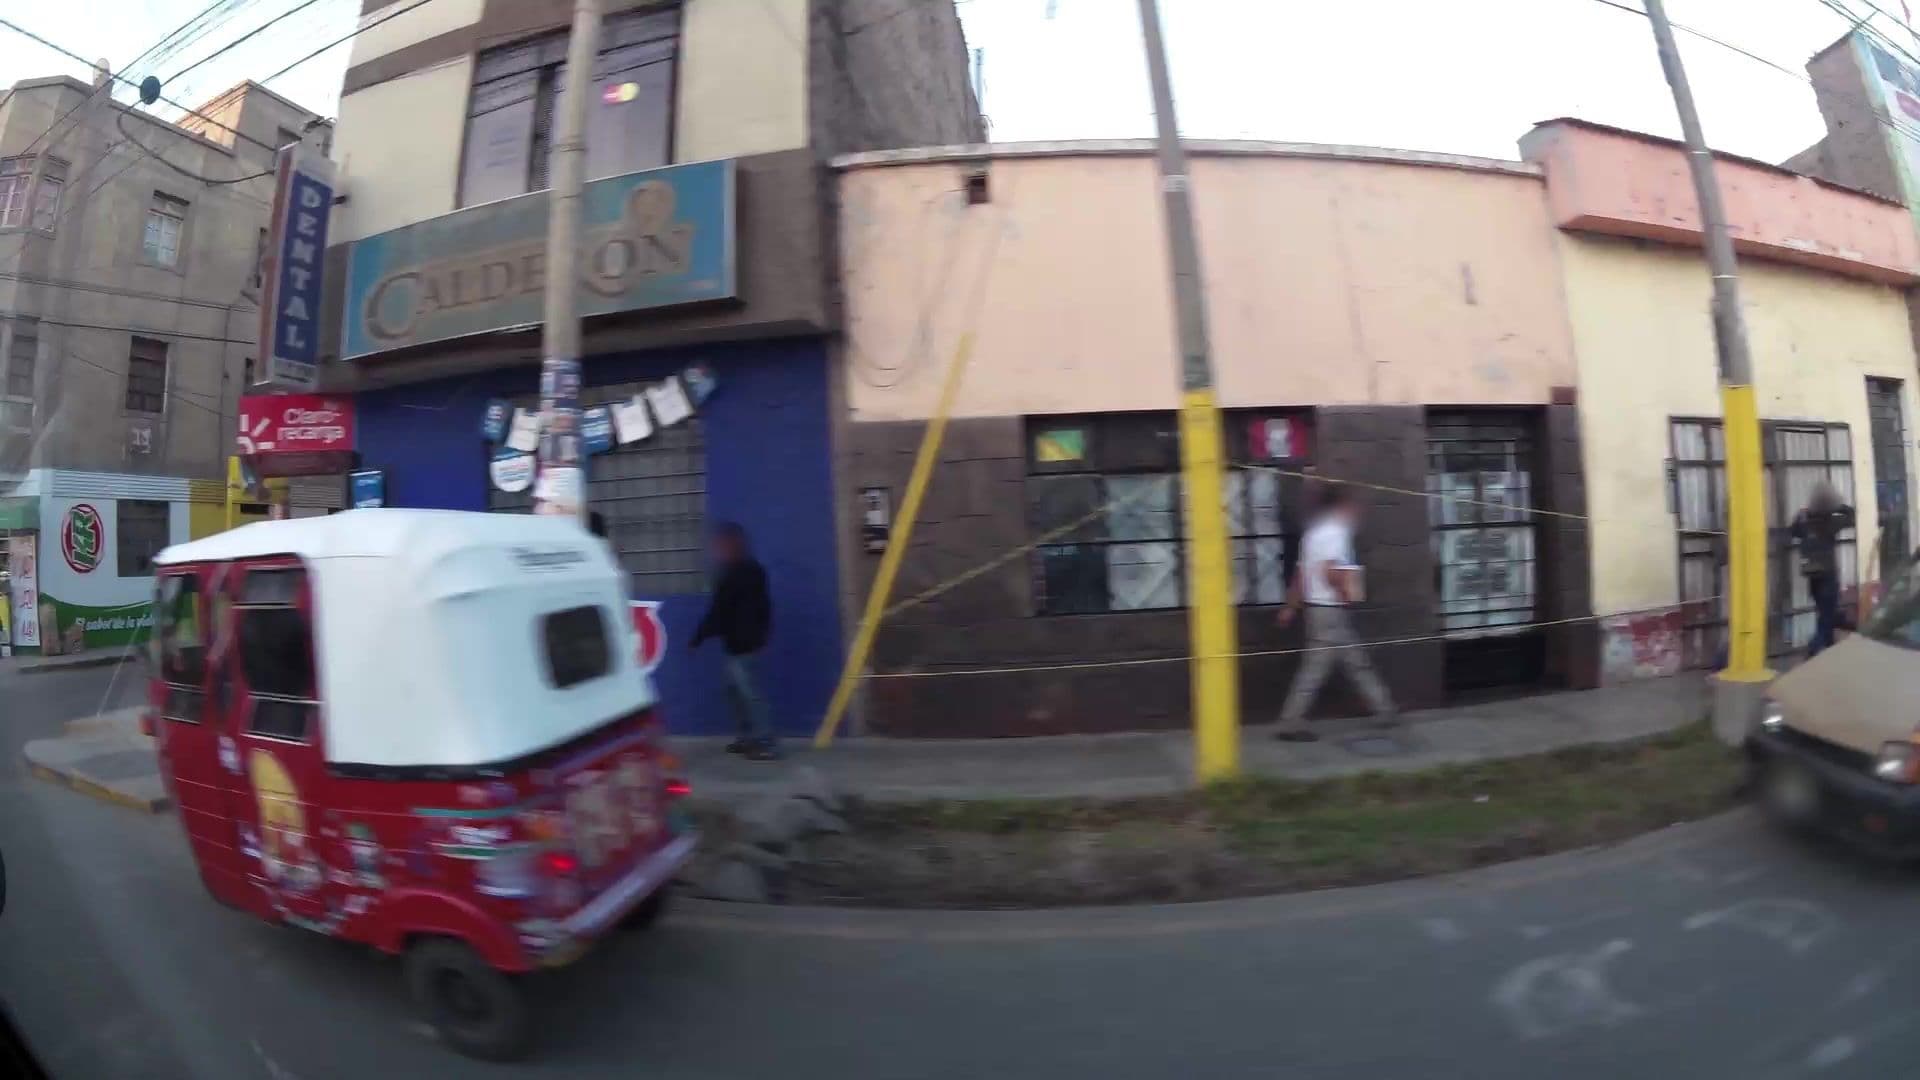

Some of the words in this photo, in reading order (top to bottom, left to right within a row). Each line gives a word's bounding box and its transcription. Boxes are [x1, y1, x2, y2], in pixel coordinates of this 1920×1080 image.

[284, 185, 322, 348] DENTAL
[365, 231, 690, 341] CALDEON
[277, 426, 345, 443] recarga
